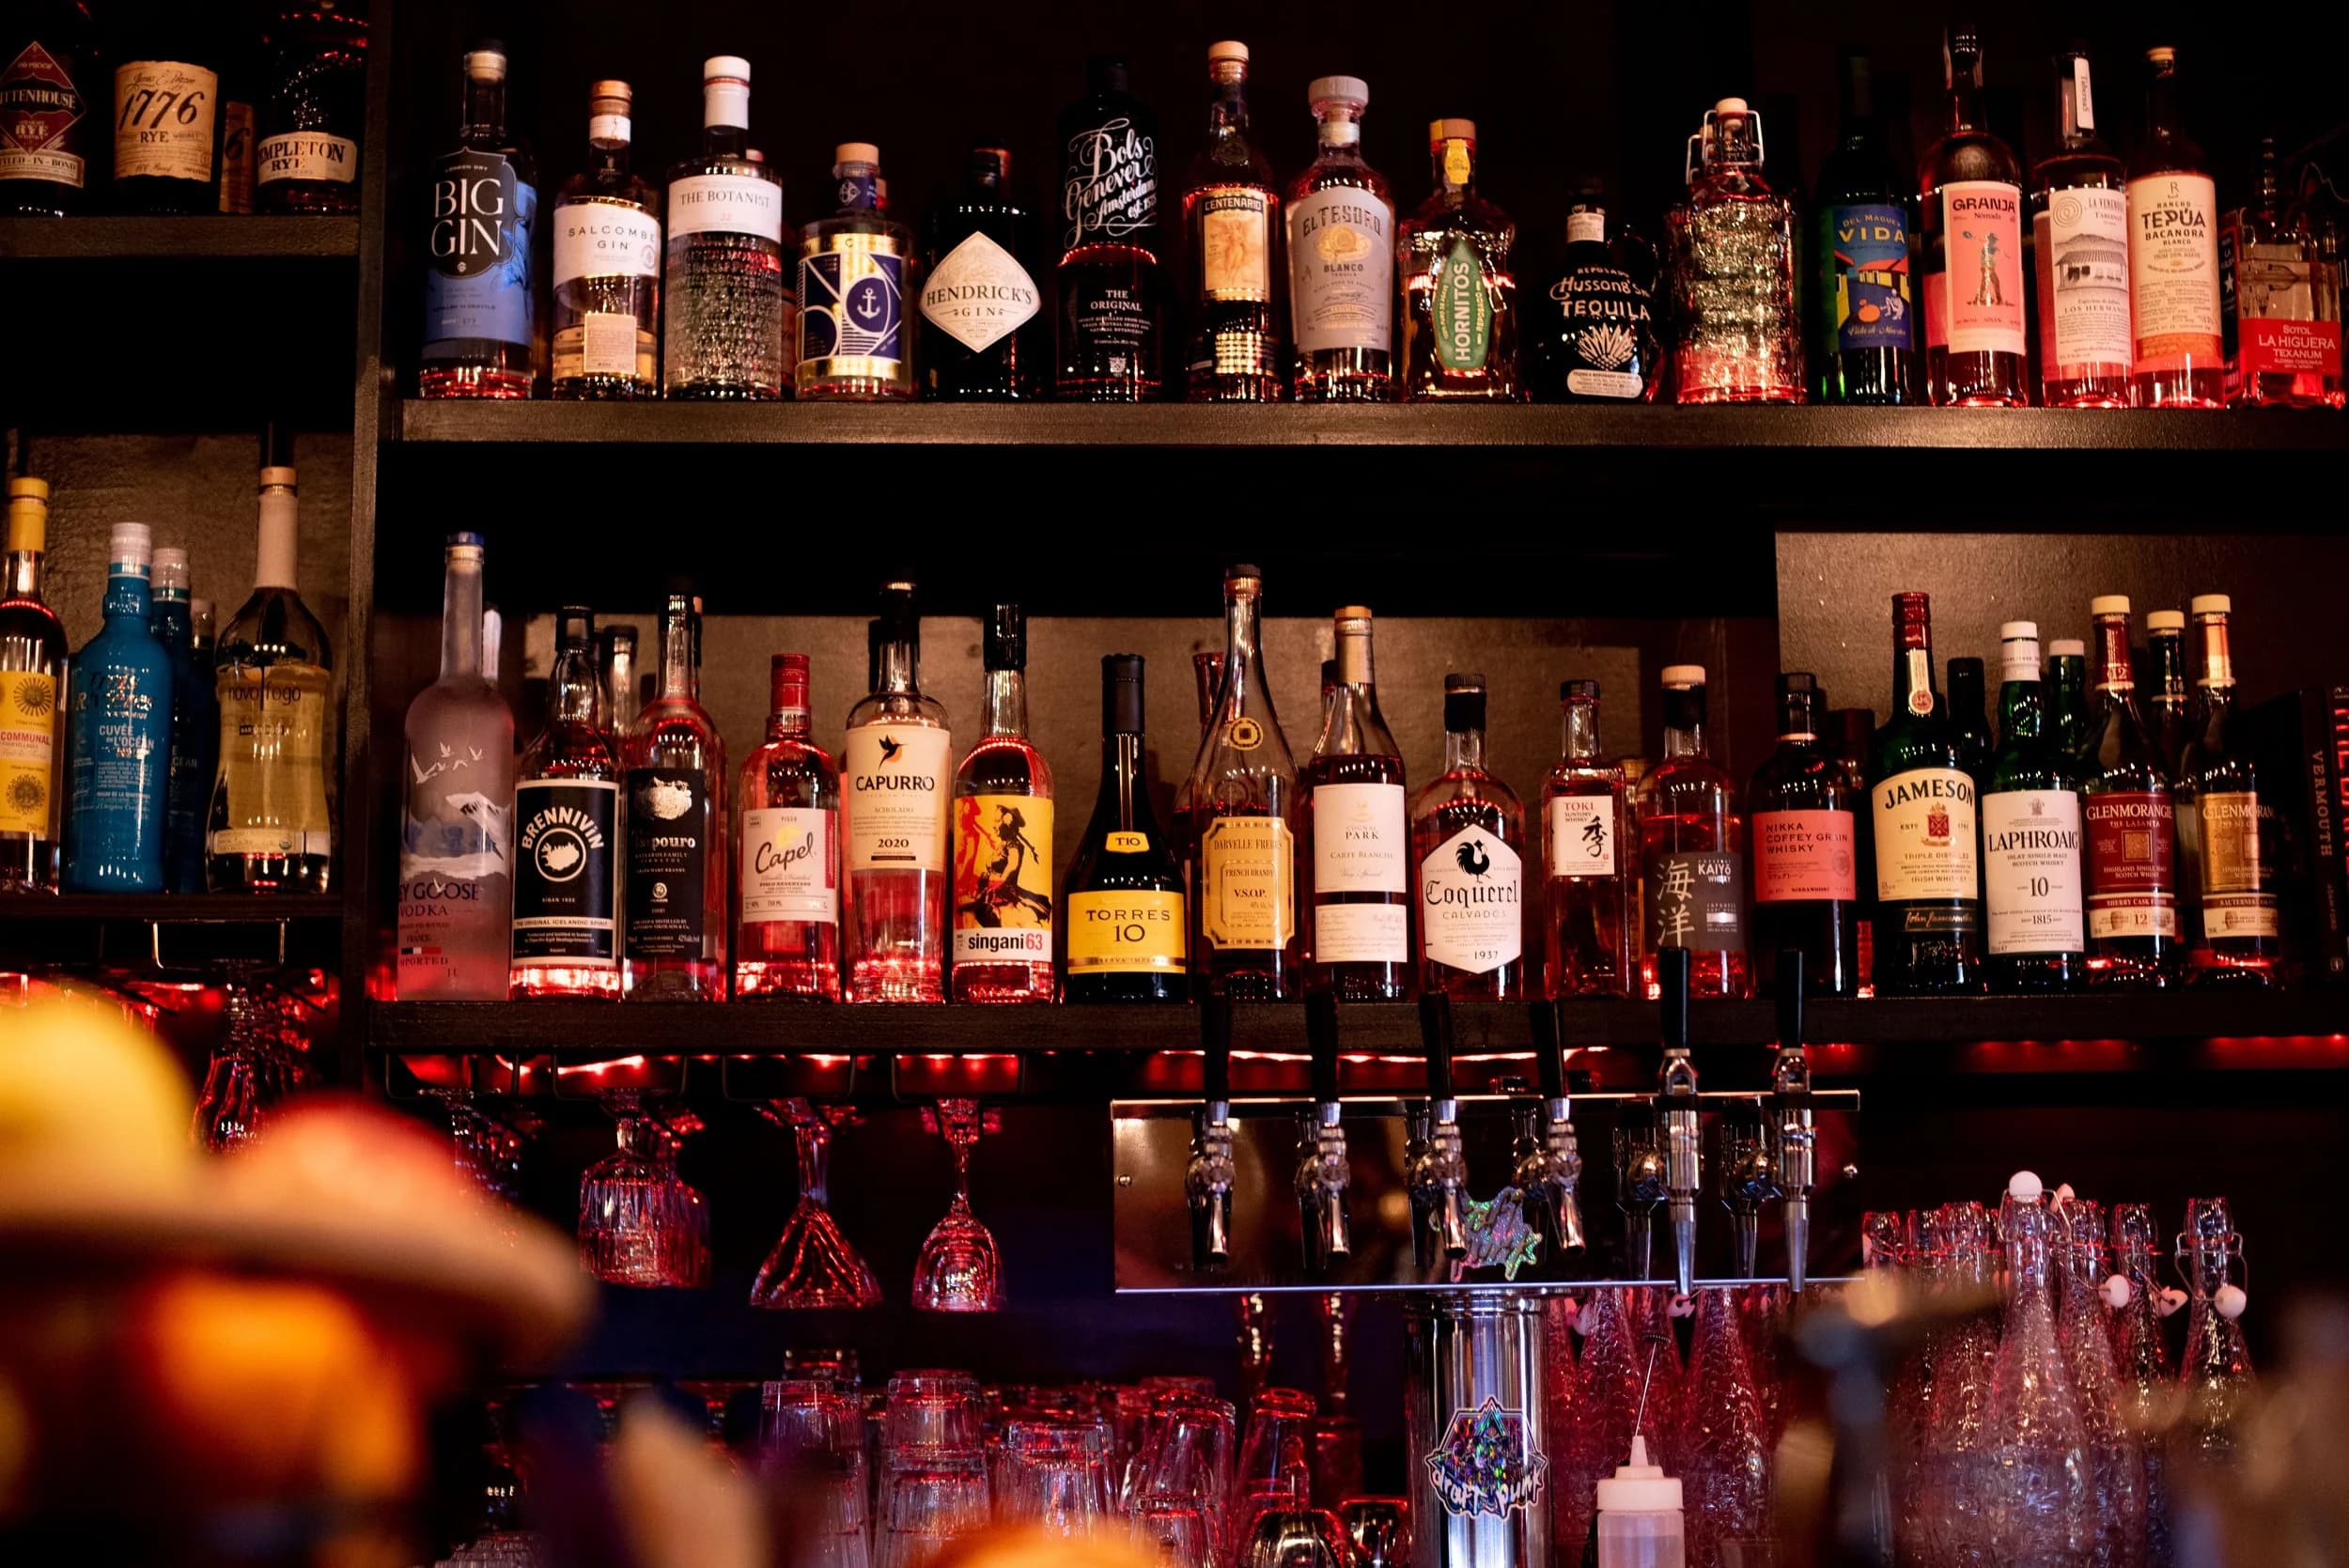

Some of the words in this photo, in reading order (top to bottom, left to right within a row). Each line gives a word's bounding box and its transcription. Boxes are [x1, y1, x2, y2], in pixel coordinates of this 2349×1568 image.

[118, 89, 205, 131] 1776
[16, 124, 49, 136] RYE
[140, 131, 169, 144] RYE
[1067, 117, 1144, 194] Bols
[52, 159, 76, 170] BOND
[272, 158, 306, 172] RYE
[434, 178, 505, 218] BIG
[679, 192, 705, 206] THE
[708, 190, 780, 209] BOTANIST
[1204, 196, 1263, 212] CENTENARIO
[1952, 197, 2016, 213] GRANJA
[1302, 216, 1318, 238] EL
[1317, 205, 1381, 237] TESORO
[1843, 217, 1860, 227] DEL
[2141, 209, 2206, 229] TEPÚA
[430, 218, 504, 257] GIN
[568, 225, 656, 243] SALCOMBE
[1838, 225, 1906, 245] VIDA
[2145, 227, 2205, 242] BACANORA
[598, 240, 630, 251] GIN
[2163, 238, 2191, 246] BLANCO
[1324, 263, 1364, 273] BLANCO
[1577, 266, 1630, 278] REPOSADO
[926, 285, 1033, 306] HENDRICK'S
[1105, 289, 1129, 300] THE
[961, 307, 997, 317] GIN
[1090, 301, 1143, 312] ORIGINAL
[1453, 262, 1471, 363] HORNITOS
[1560, 300, 1652, 321] TEQUILA
[2283, 323, 2313, 335] SOTOL
[2258, 334, 2277, 347] LA
[2278, 337, 2336, 350] HIGUERA
[2272, 348, 2323, 360] TEXANUM
[228, 685, 260, 702] novo
[266, 681, 302, 706] fogo
[99, 723, 134, 737] CUVÉE
[0, 731, 51, 746] COMMUNAL
[855, 775, 936, 791] CAPURRO
[1884, 779, 1974, 811] JAMESON
[874, 805, 914, 815] ACHOLADO
[1563, 801, 1595, 812] TOKI
[2310, 750, 2333, 858] VERMOUTH
[1766, 822, 1805, 833] NIKKA
[2125, 819, 2161, 828] LASANTA
[1346, 831, 1379, 840] PARK
[1766, 833, 1812, 844] COFFEY
[1815, 833, 1848, 843] GRAIN
[1988, 830, 2078, 852] LAPHROAIG
[878, 838, 910, 848] 2020
[1214, 838, 1253, 850] DARVELLE
[1766, 844, 1814, 855] WHISKY
[754, 831, 815, 875] Capel
[1330, 851, 1357, 860] CARTE
[1225, 869, 1251, 877] FRENCH
[1251, 869, 1274, 877] BRANDY
[2103, 864, 2135, 873] HIGHLAND
[1911, 876, 1934, 884] IRISH
[2030, 877, 2049, 897] 10
[412, 881, 480, 901] GOOSE
[1425, 879, 1519, 908] Coquerel
[399, 904, 448, 918] VODKA
[1656, 859, 1696, 949] 海洋
[1085, 909, 1172, 923] TORRES
[1442, 909, 1507, 920] CALVADOS
[2032, 915, 2052, 925] 1815
[2134, 913, 2148, 926] 12
[552, 918, 588, 926] ICELANDIC
[1113, 924, 1145, 943] 10
[1474, 950, 1499, 960] 1937
